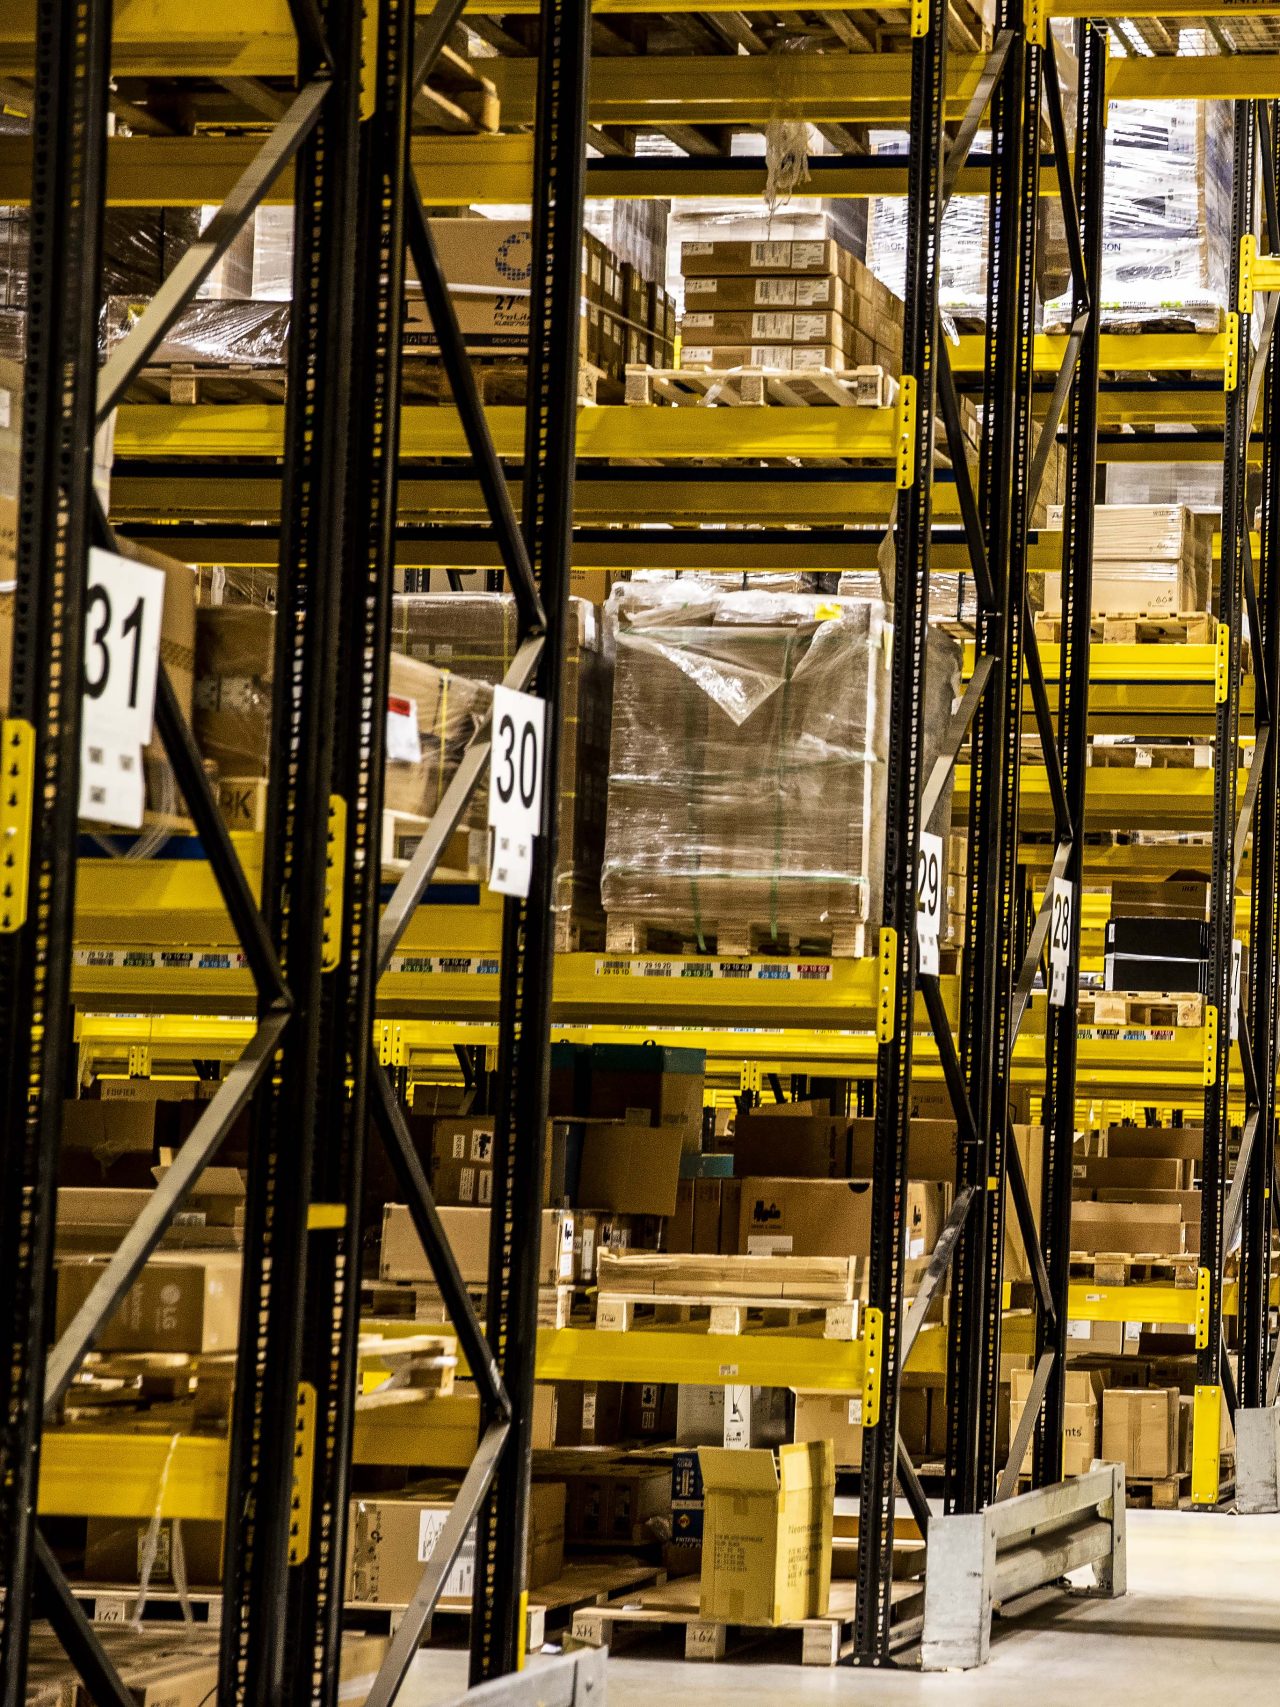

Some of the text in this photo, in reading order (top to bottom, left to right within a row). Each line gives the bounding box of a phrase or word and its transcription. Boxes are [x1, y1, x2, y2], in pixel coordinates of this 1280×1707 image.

[84, 582, 146, 710] 31
[496, 714, 536, 810] 30
[918, 848, 938, 916] 29
[1052, 894, 1070, 952] 28
